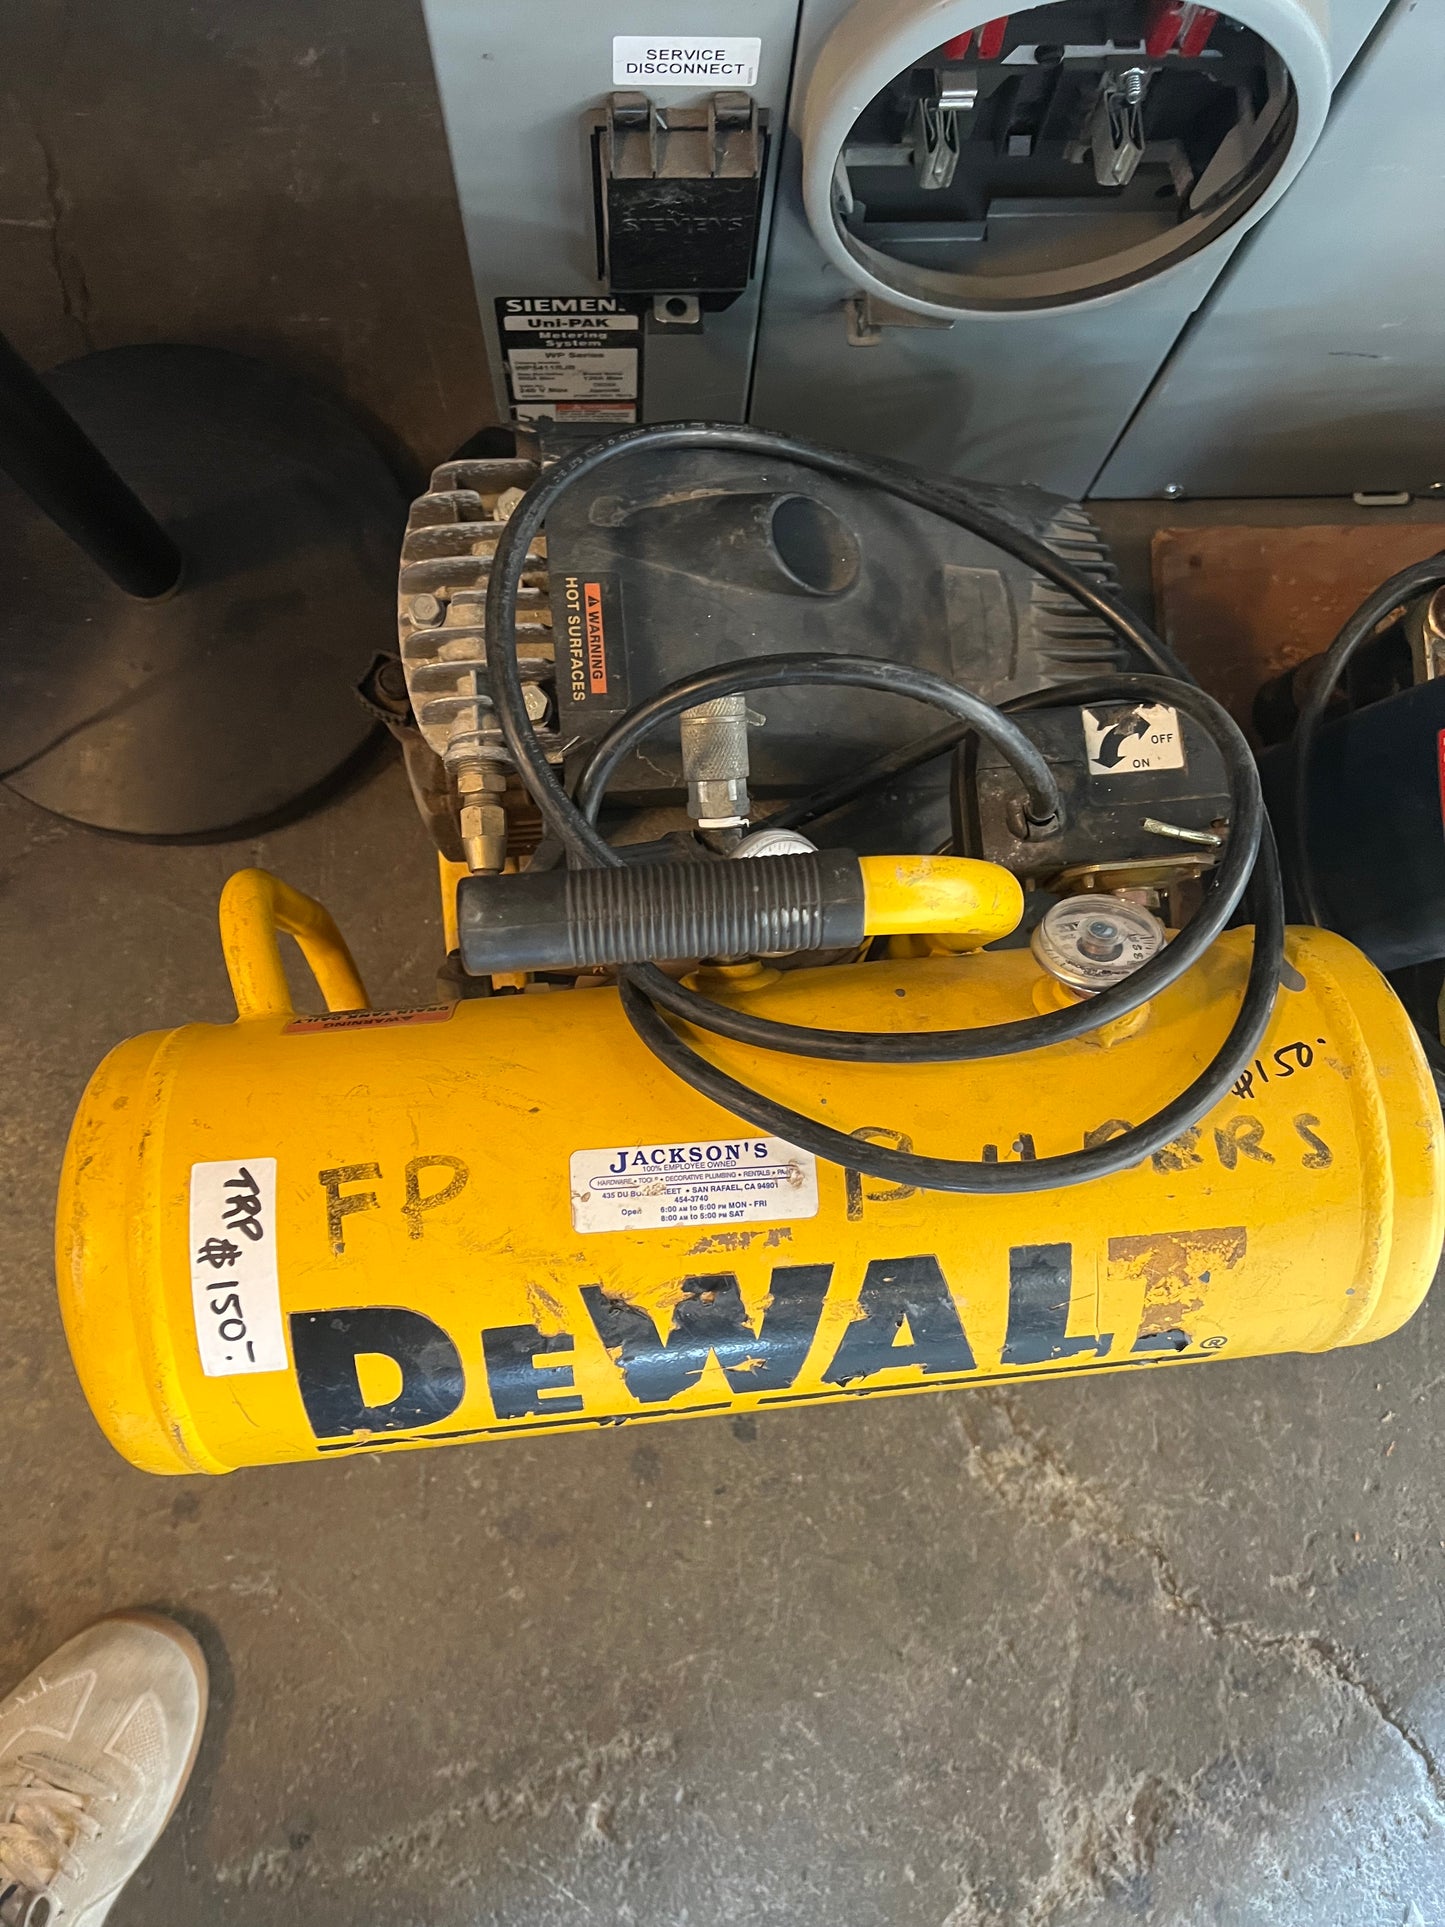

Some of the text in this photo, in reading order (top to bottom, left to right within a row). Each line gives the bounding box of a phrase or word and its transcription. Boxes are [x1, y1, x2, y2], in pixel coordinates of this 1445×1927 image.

[646, 49, 726, 60] SERVICE
[626, 63, 745, 74] DISCONNECT
[506, 299, 626, 312] SIEMEN
[527, 318, 610, 328] Uni-PAK
[539, 332, 608, 340] Metering
[545, 340, 602, 348] System
[565, 577, 586, 701] HOT SURFACES
[588, 611, 603, 680] WARNING
[1150, 734, 1173, 744] OFF
[1132, 759, 1150, 768] ON
[293, 1005, 449, 1024] DRAIN TANK DAILY
[323, 1015, 401, 1029] WARNING
[609, 1142, 769, 1173] JACKSON'S
[664, 1162, 706, 1171] EMPLOYEE
[707, 1160, 736, 1169] OWNED
[597, 1178, 633, 1186] HARDWARE
[665, 1173, 704, 1182] DECORATIVE
[704, 1171, 736, 1180] PLUMBING
[743, 1169, 771, 1177] RENTALS
[692, 1186, 709, 1194] SAN
[710, 1183, 743, 1193] RAFAEL,
[757, 1181, 779, 1190] 94901
[222, 1167, 264, 1242] TRP
[674, 1195, 709, 1203] 454-3740
[318, 1155, 470, 1255] FP
[728, 1201, 747, 1209] MON
[728, 1210, 745, 1218] SAT
